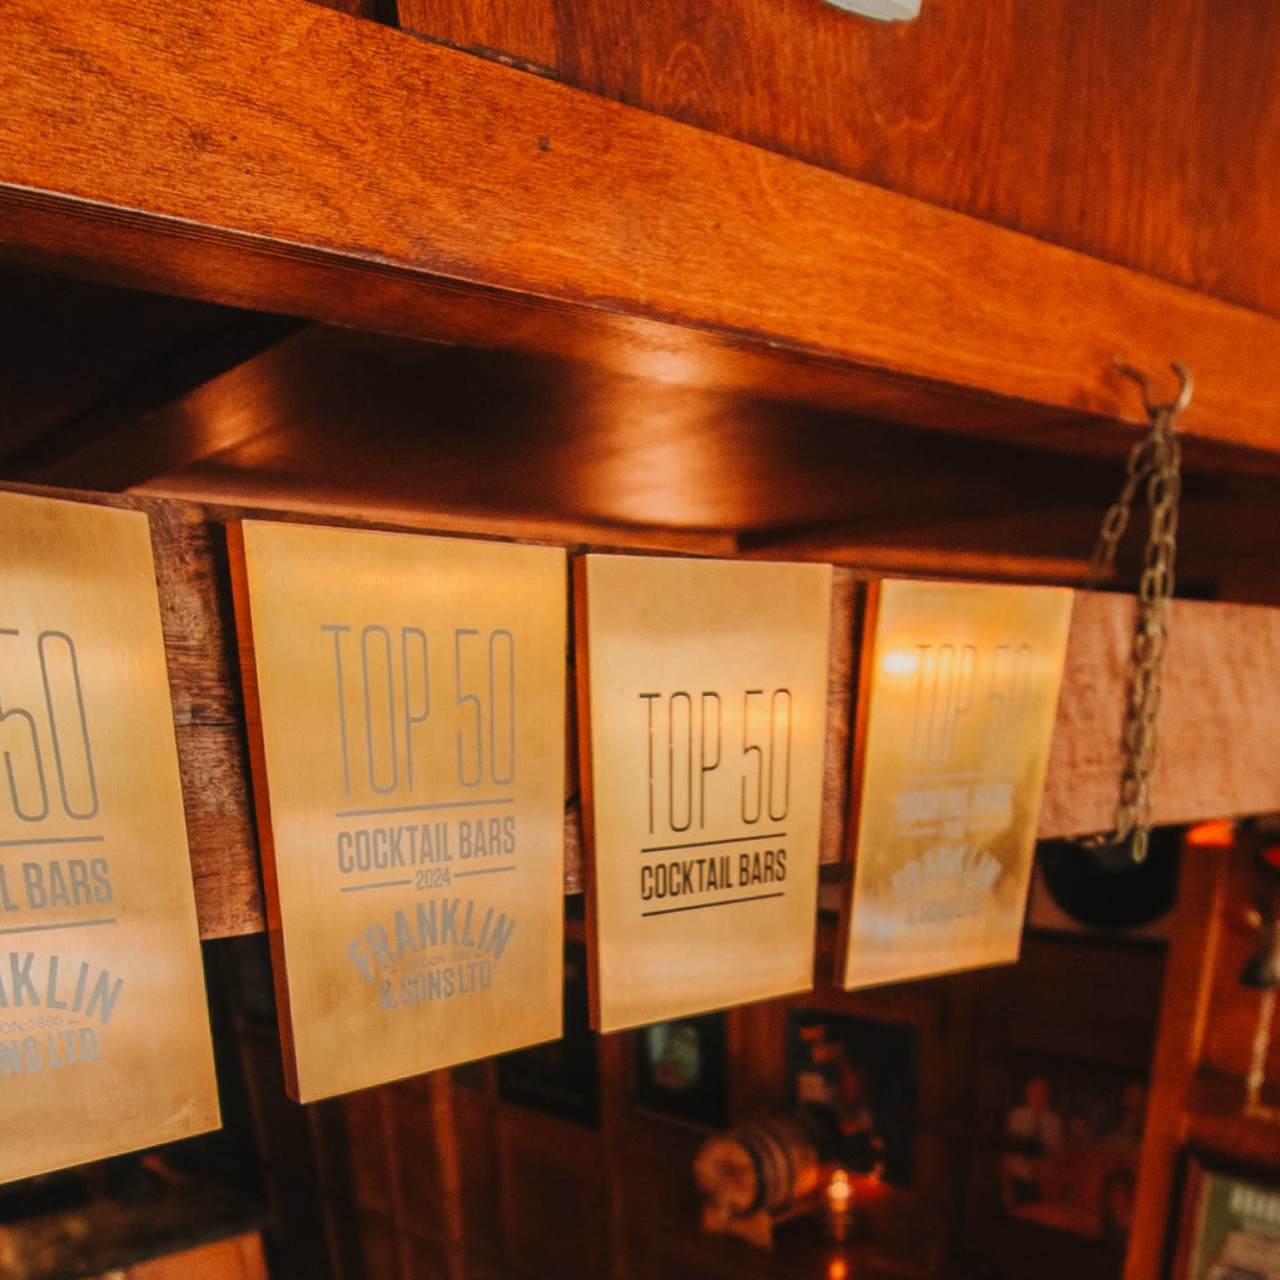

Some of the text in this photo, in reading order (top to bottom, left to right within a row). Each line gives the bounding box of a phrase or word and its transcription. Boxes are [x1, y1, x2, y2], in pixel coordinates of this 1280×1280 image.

[320, 623, 514, 794] TOP 50
[908, 643, 975, 766] TOP
[639, 687, 792, 833] TOP 50
[336, 815, 515, 873] COCKTAIL BARS
[23, 857, 112, 907] BARS
[415, 867, 450, 889] 2024
[639, 848, 786, 900] COCKTAIL BARS
[346, 897, 514, 983] FRANKLIN
[400, 966, 453, 1004] SONS
[458, 958, 491, 992] LTD
[46, 1026, 99, 1067] LTD
